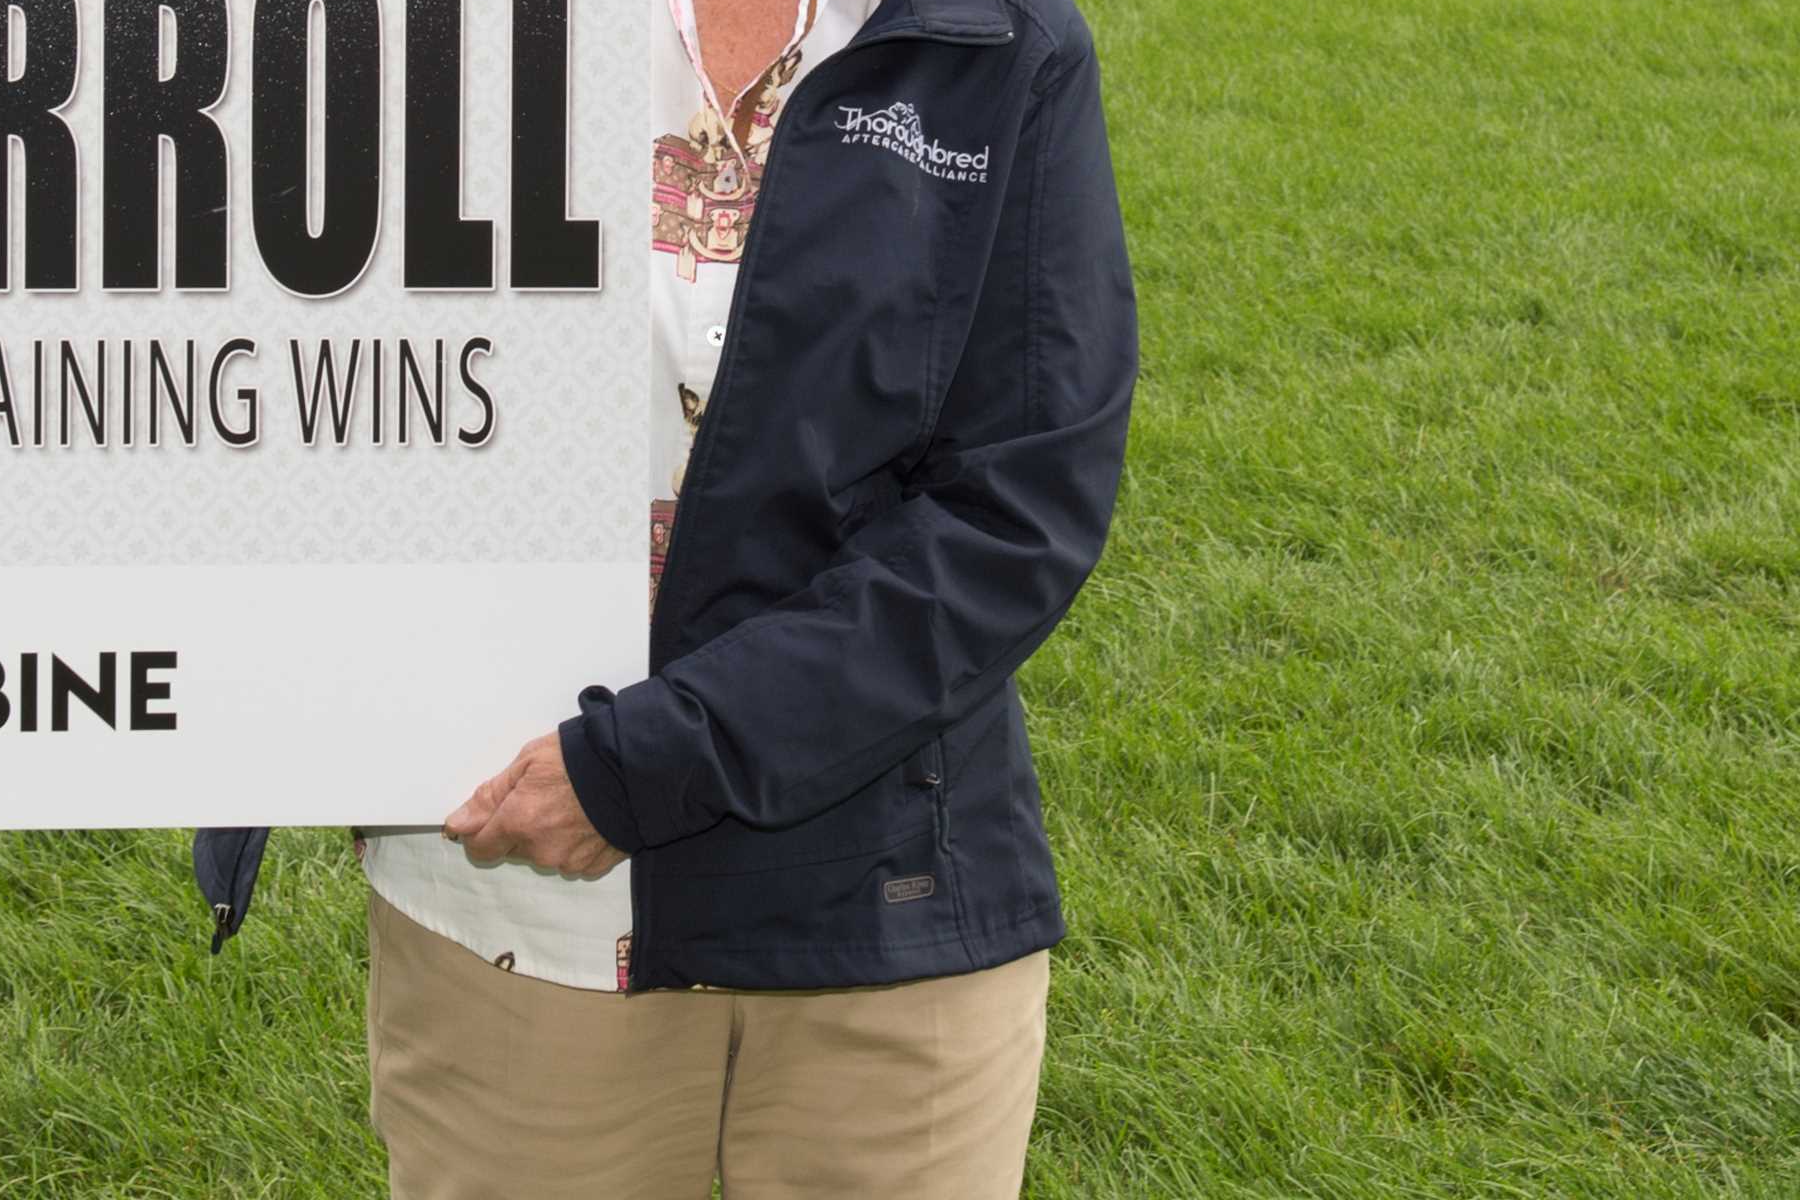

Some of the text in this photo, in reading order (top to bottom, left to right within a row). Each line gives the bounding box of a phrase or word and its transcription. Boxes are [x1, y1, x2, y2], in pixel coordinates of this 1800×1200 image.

[834, 106, 989, 170] Thoroughbred
[841, 134, 988, 184] AFTERCARE ALLIANCE
[291, 337, 493, 446] WINS
